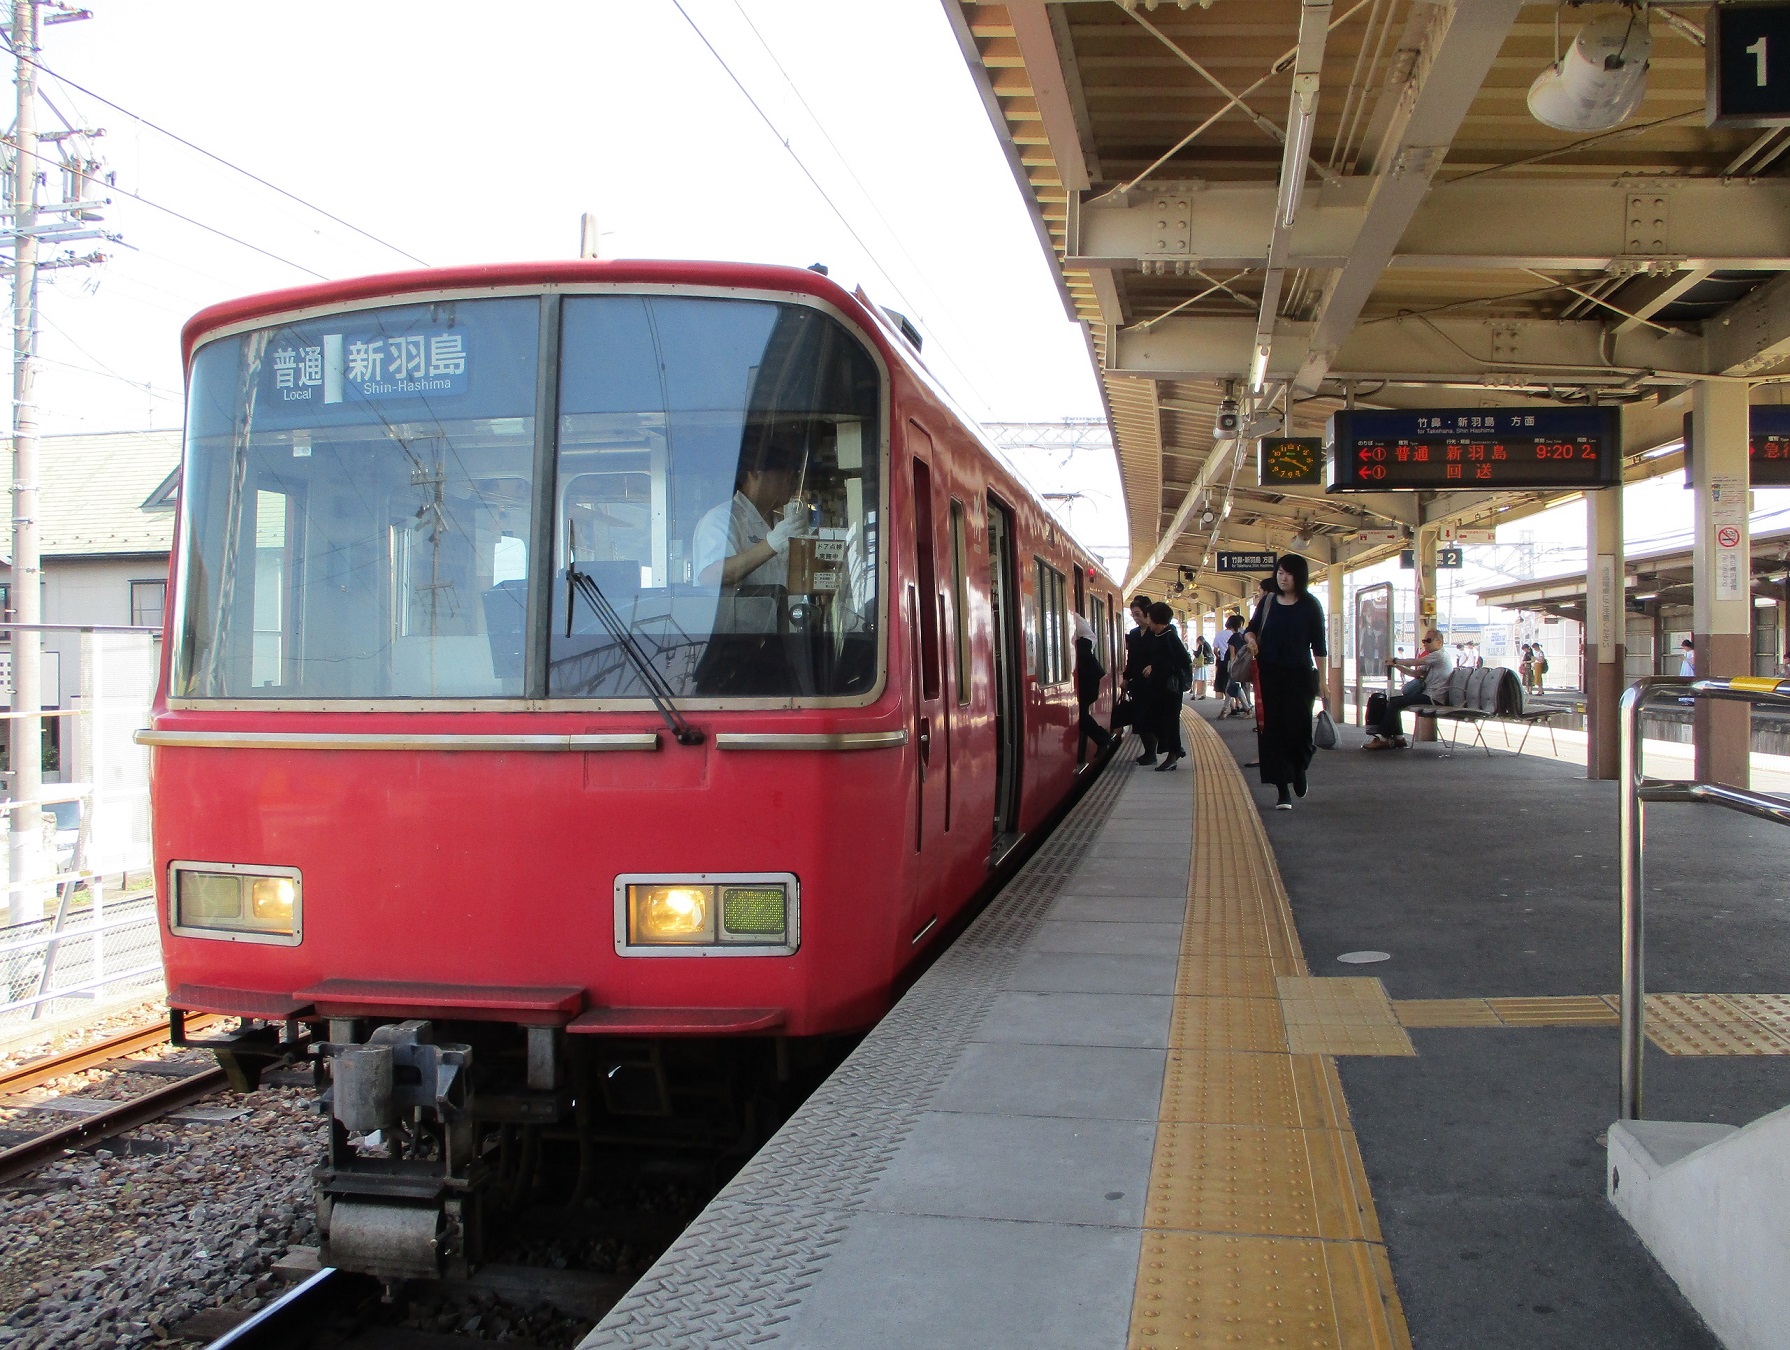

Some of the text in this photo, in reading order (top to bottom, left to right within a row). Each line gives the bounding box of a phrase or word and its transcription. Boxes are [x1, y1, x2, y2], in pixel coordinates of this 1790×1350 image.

[1745, 36, 1768, 87] 1
[273, 333, 466, 389] 普通 新羽島
[284, 377, 451, 401] Local Shin-Hashima
[1417, 415, 1535, 428] 竹鼻・新羽島 方面
[1395, 445, 1429, 461] 普通
[1446, 445, 1507, 461] 新羽島
[1536, 444, 1573, 459] 9:20
[1446, 463, 1492, 479] 回送
[1221, 556, 1228, 568] 1
[1447, 552, 1457, 565] 2
